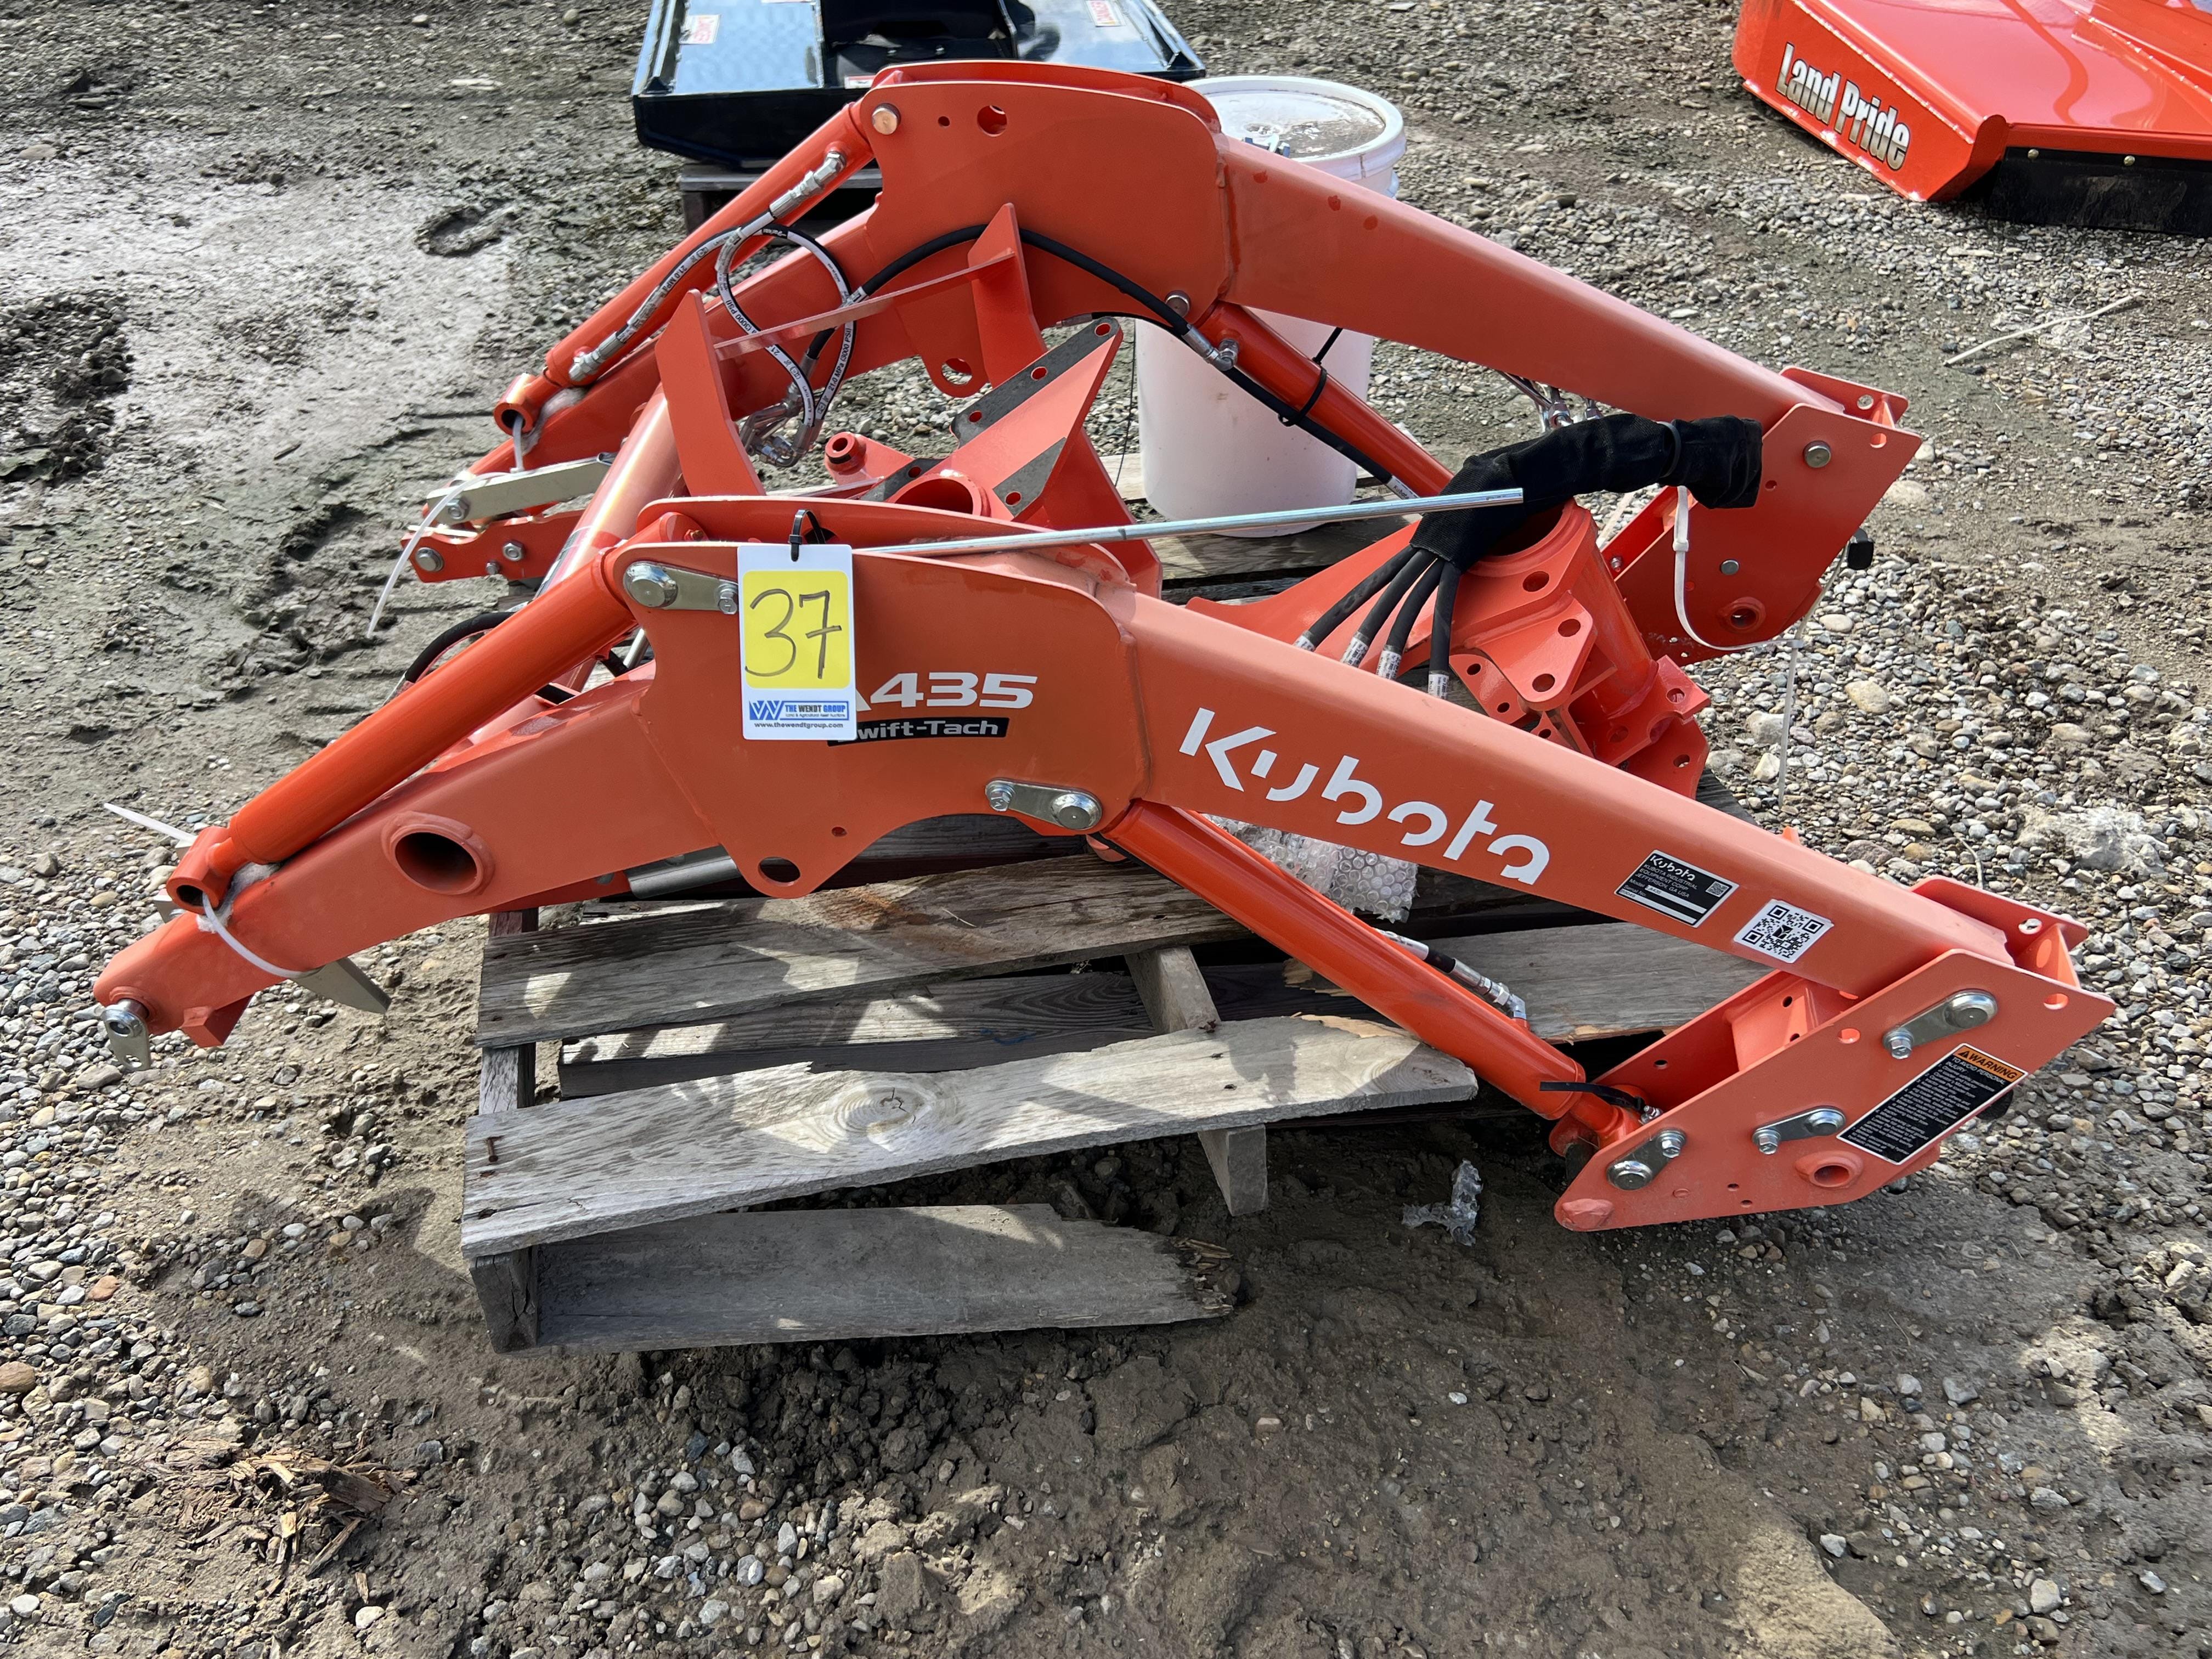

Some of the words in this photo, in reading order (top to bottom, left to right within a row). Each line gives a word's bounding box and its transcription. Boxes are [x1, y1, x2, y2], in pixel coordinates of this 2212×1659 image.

[1776, 42, 1841, 125] Land
[1835, 79, 1910, 171] Pride
[828, 376, 839, 391] 21.0
[835, 363, 845, 378] MPa
[840, 344, 850, 362] (3000
[744, 589, 842, 679] 37
[859, 720, 998, 741] wift-Tach
[1179, 708, 1550, 885] Kubota
[1639, 868, 1672, 884] EQUIPMENT
[1643, 864, 1666, 876] KUBOTA
[1667, 874, 1698, 890] INDUSTRIAL
[1650, 855, 1696, 881] Kubota
[1629, 879, 1645, 887] Model
[1959, 1061, 1978, 1070] AVOID
[1976, 1069, 2006, 1084] PERSONAL
[1968, 1053, 2017, 1079] WARNING
